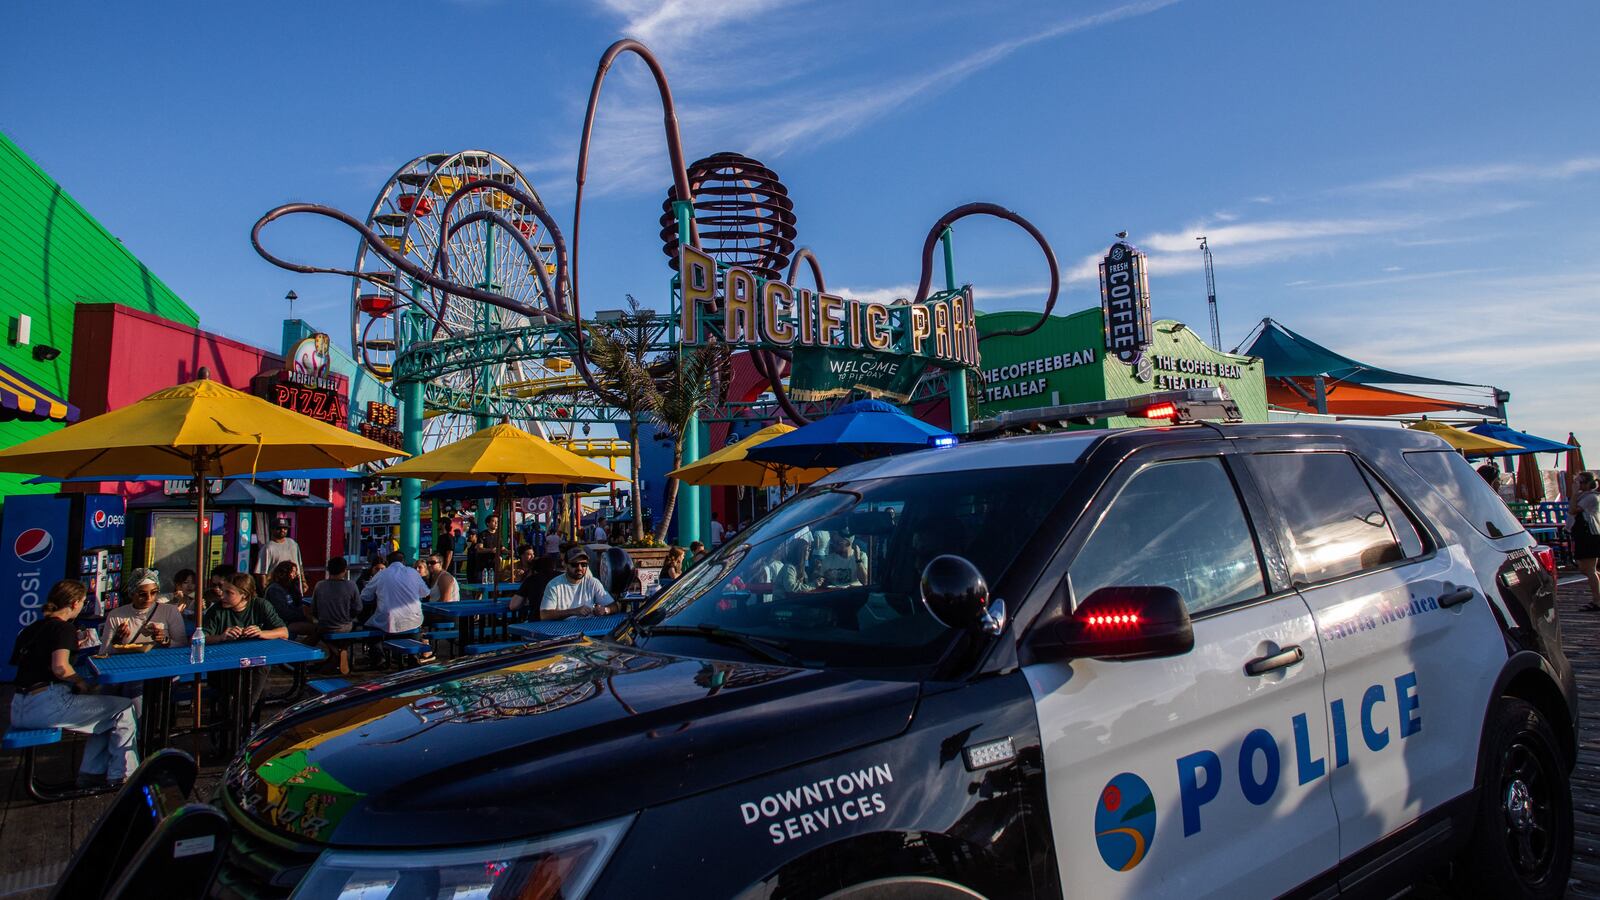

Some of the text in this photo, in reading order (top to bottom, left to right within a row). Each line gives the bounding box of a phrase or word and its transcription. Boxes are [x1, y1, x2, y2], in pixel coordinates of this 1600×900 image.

[1109, 262, 1129, 273] FRESH
[681, 243, 980, 367] PACIFIC PARK
[1110, 271, 1134, 348] COFFEE
[829, 360, 899, 375] WELCOME
[866, 371, 884, 379] DAY
[981, 368, 999, 383] HE
[1157, 356, 1242, 379] THE COFFEE BEAN
[288, 370, 338, 391] PACIFIC WHEEL
[1167, 376, 1186, 389] TEA
[276, 385, 343, 422] PIZZA
[528, 498, 547, 511] 66
[107, 514, 125, 528] peps
[18, 568, 45, 635] epsi
[1175, 671, 1422, 838] POLICE
[740, 763, 893, 825] DOWNTOWN
[768, 792, 886, 844] SERVICES
